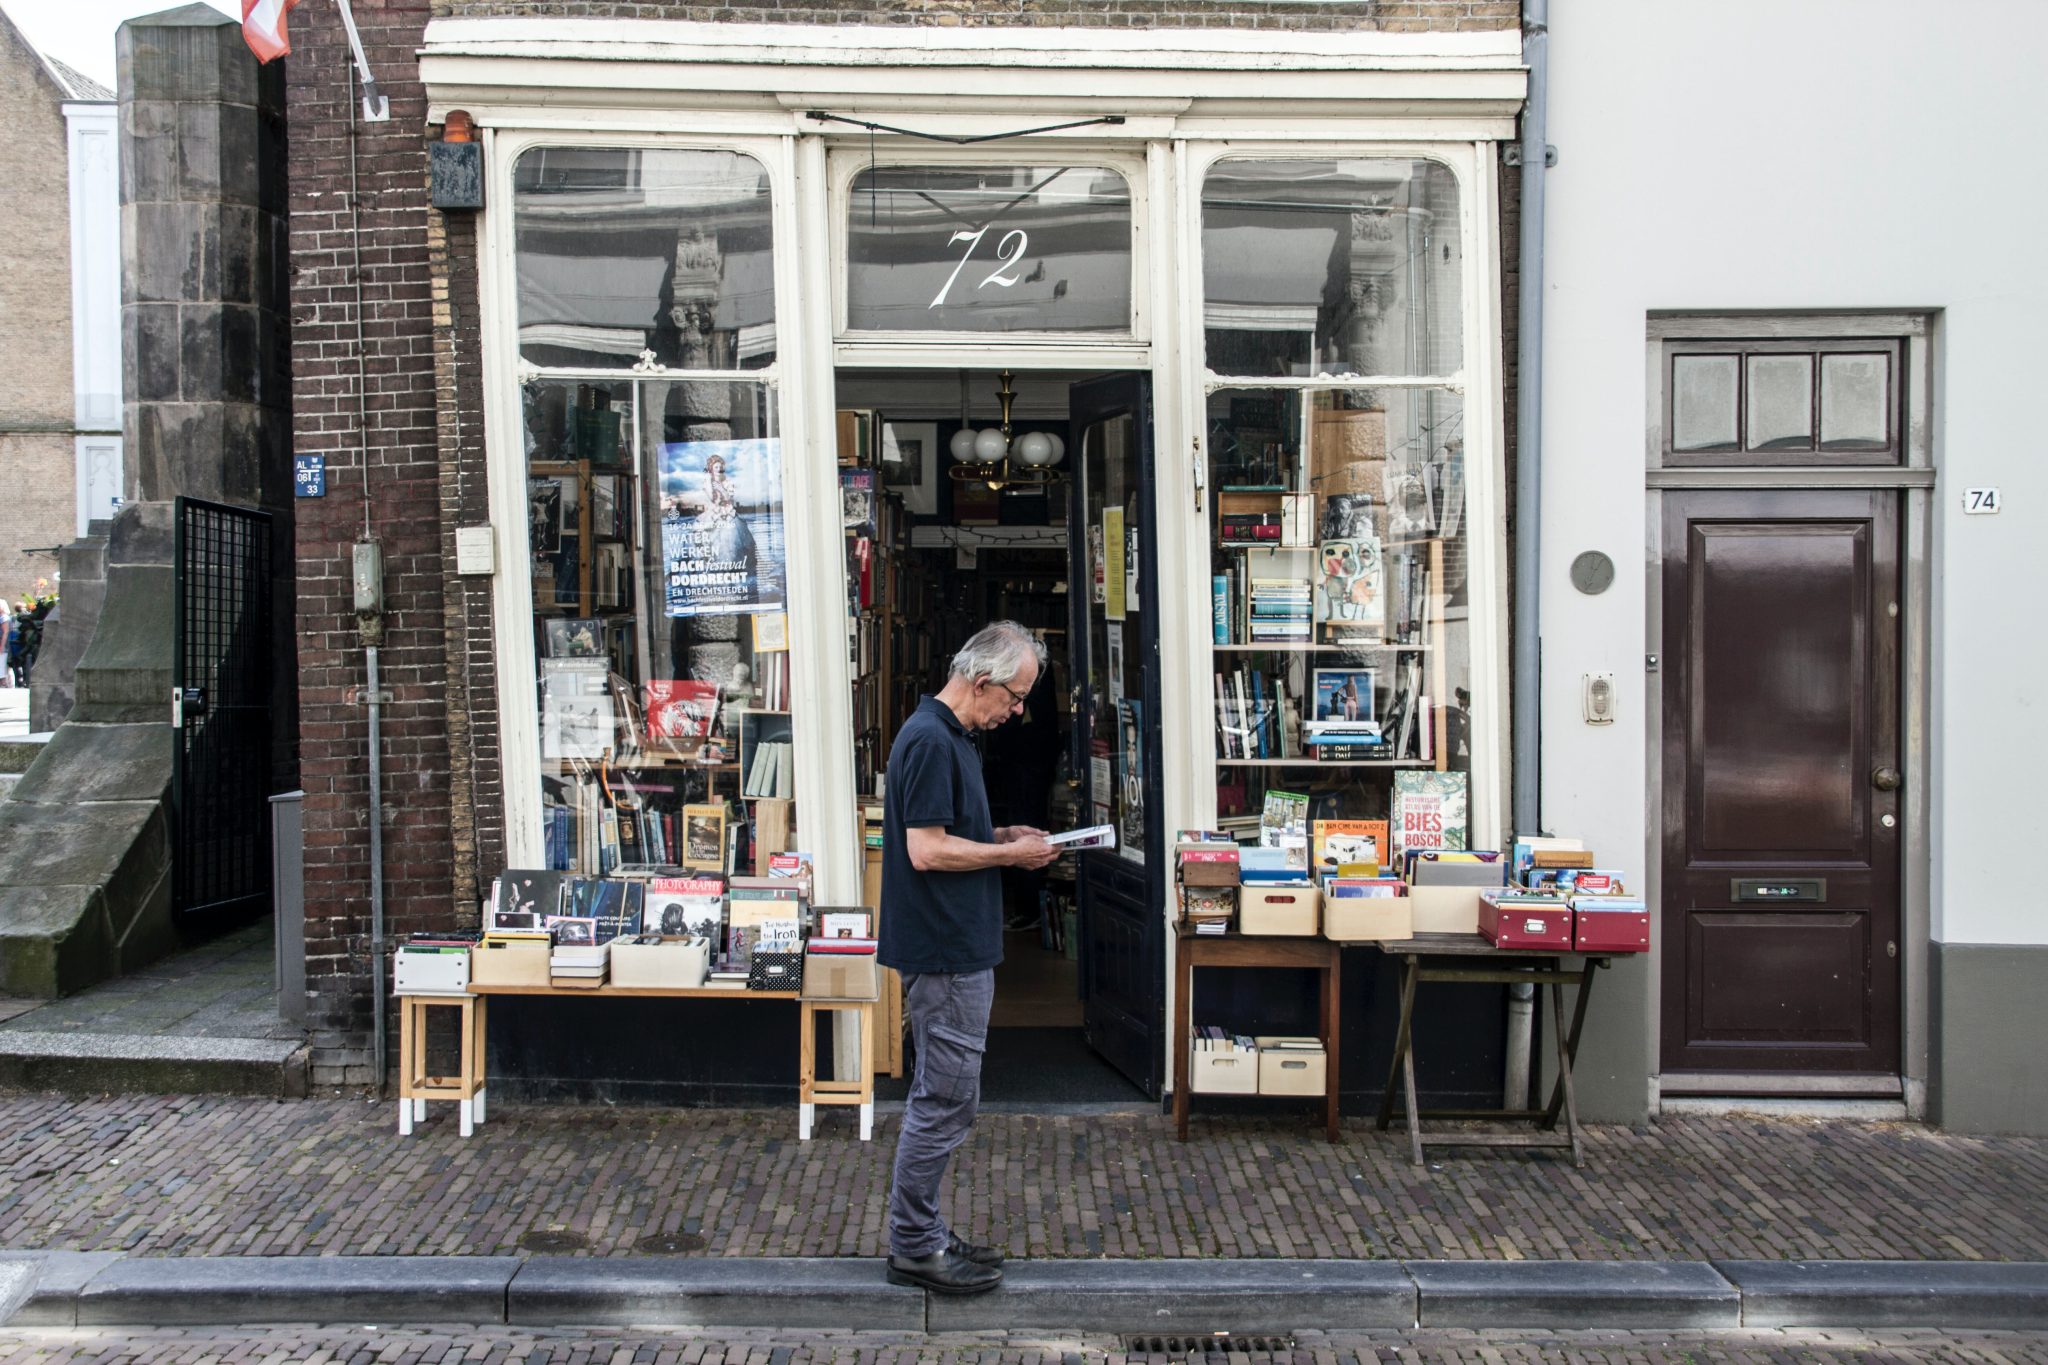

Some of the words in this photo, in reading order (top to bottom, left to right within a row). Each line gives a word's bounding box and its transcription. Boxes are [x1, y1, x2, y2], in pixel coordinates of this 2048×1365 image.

[928, 224, 1028, 310] 72
[296, 460, 307, 469] AL
[307, 484, 318, 494] 33
[1971, 490, 1995, 509] 74
[669, 531, 710, 545] WATER
[669, 545, 720, 558] WERKEN
[671, 560, 704, 573] BACH
[705, 555, 748, 573] festival
[671, 571, 748, 586] DORDRECHT
[672, 588, 683, 597] EN
[685, 585, 748, 596] DRECHTSTEDEN
[1405, 812, 1442, 832] BIES
[688, 841, 718, 851] Dromen
[1405, 834, 1442, 846] BOSCH
[655, 879, 721, 892] PHOTOGRAPHY
[774, 928, 797, 940] Iron
